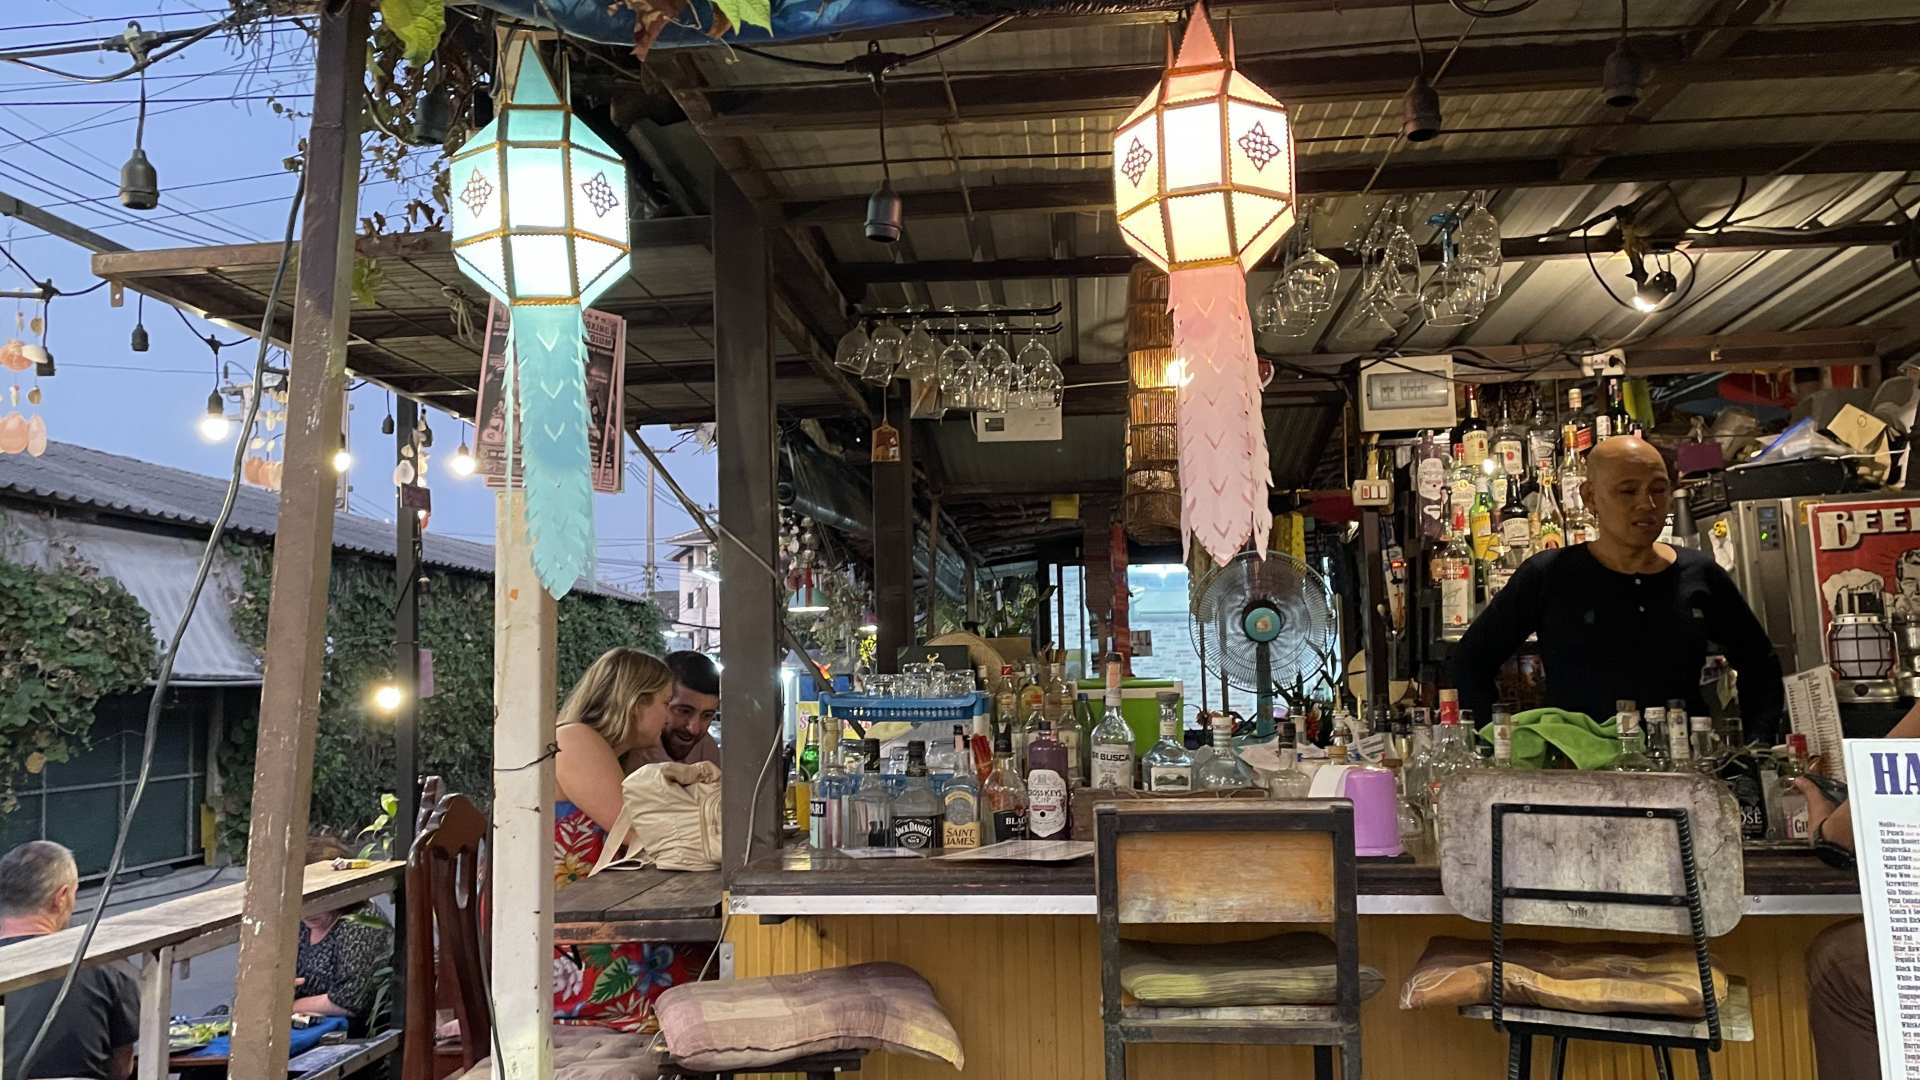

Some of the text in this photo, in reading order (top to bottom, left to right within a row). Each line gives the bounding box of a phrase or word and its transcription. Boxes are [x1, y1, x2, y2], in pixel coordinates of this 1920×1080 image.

[1100, 752, 1130, 761] BUSCA
[895, 824, 909, 836] JACK
[947, 828, 975, 837] SAINT
[945, 837, 975, 846] JAMES
